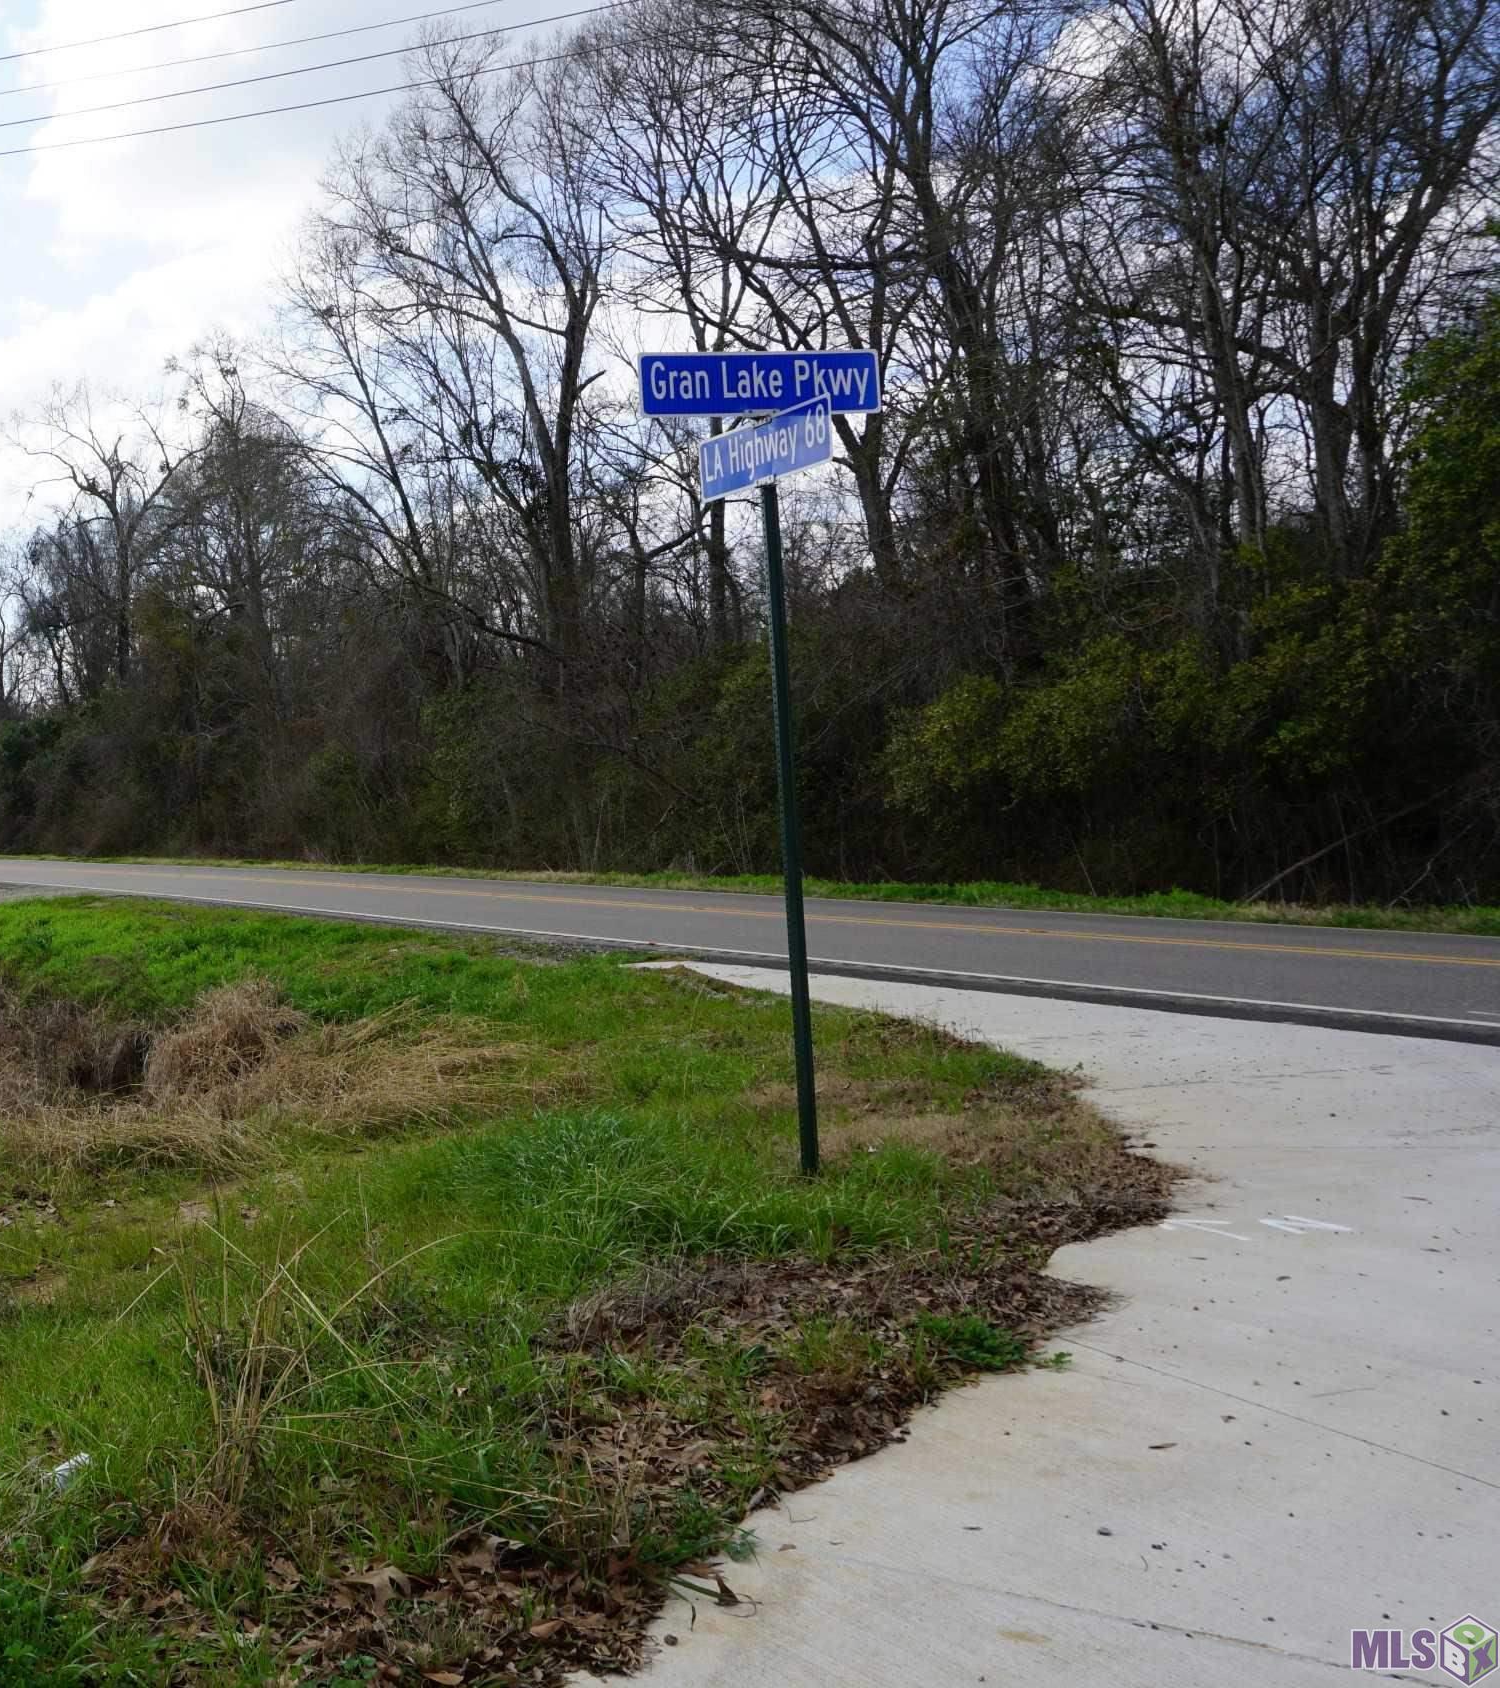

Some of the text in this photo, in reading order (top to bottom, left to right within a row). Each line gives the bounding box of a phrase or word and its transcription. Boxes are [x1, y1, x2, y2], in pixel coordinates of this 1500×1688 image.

[650, 359, 869, 405] Gran Lake Pkwy
[703, 402, 826, 482] LA Highway 68
